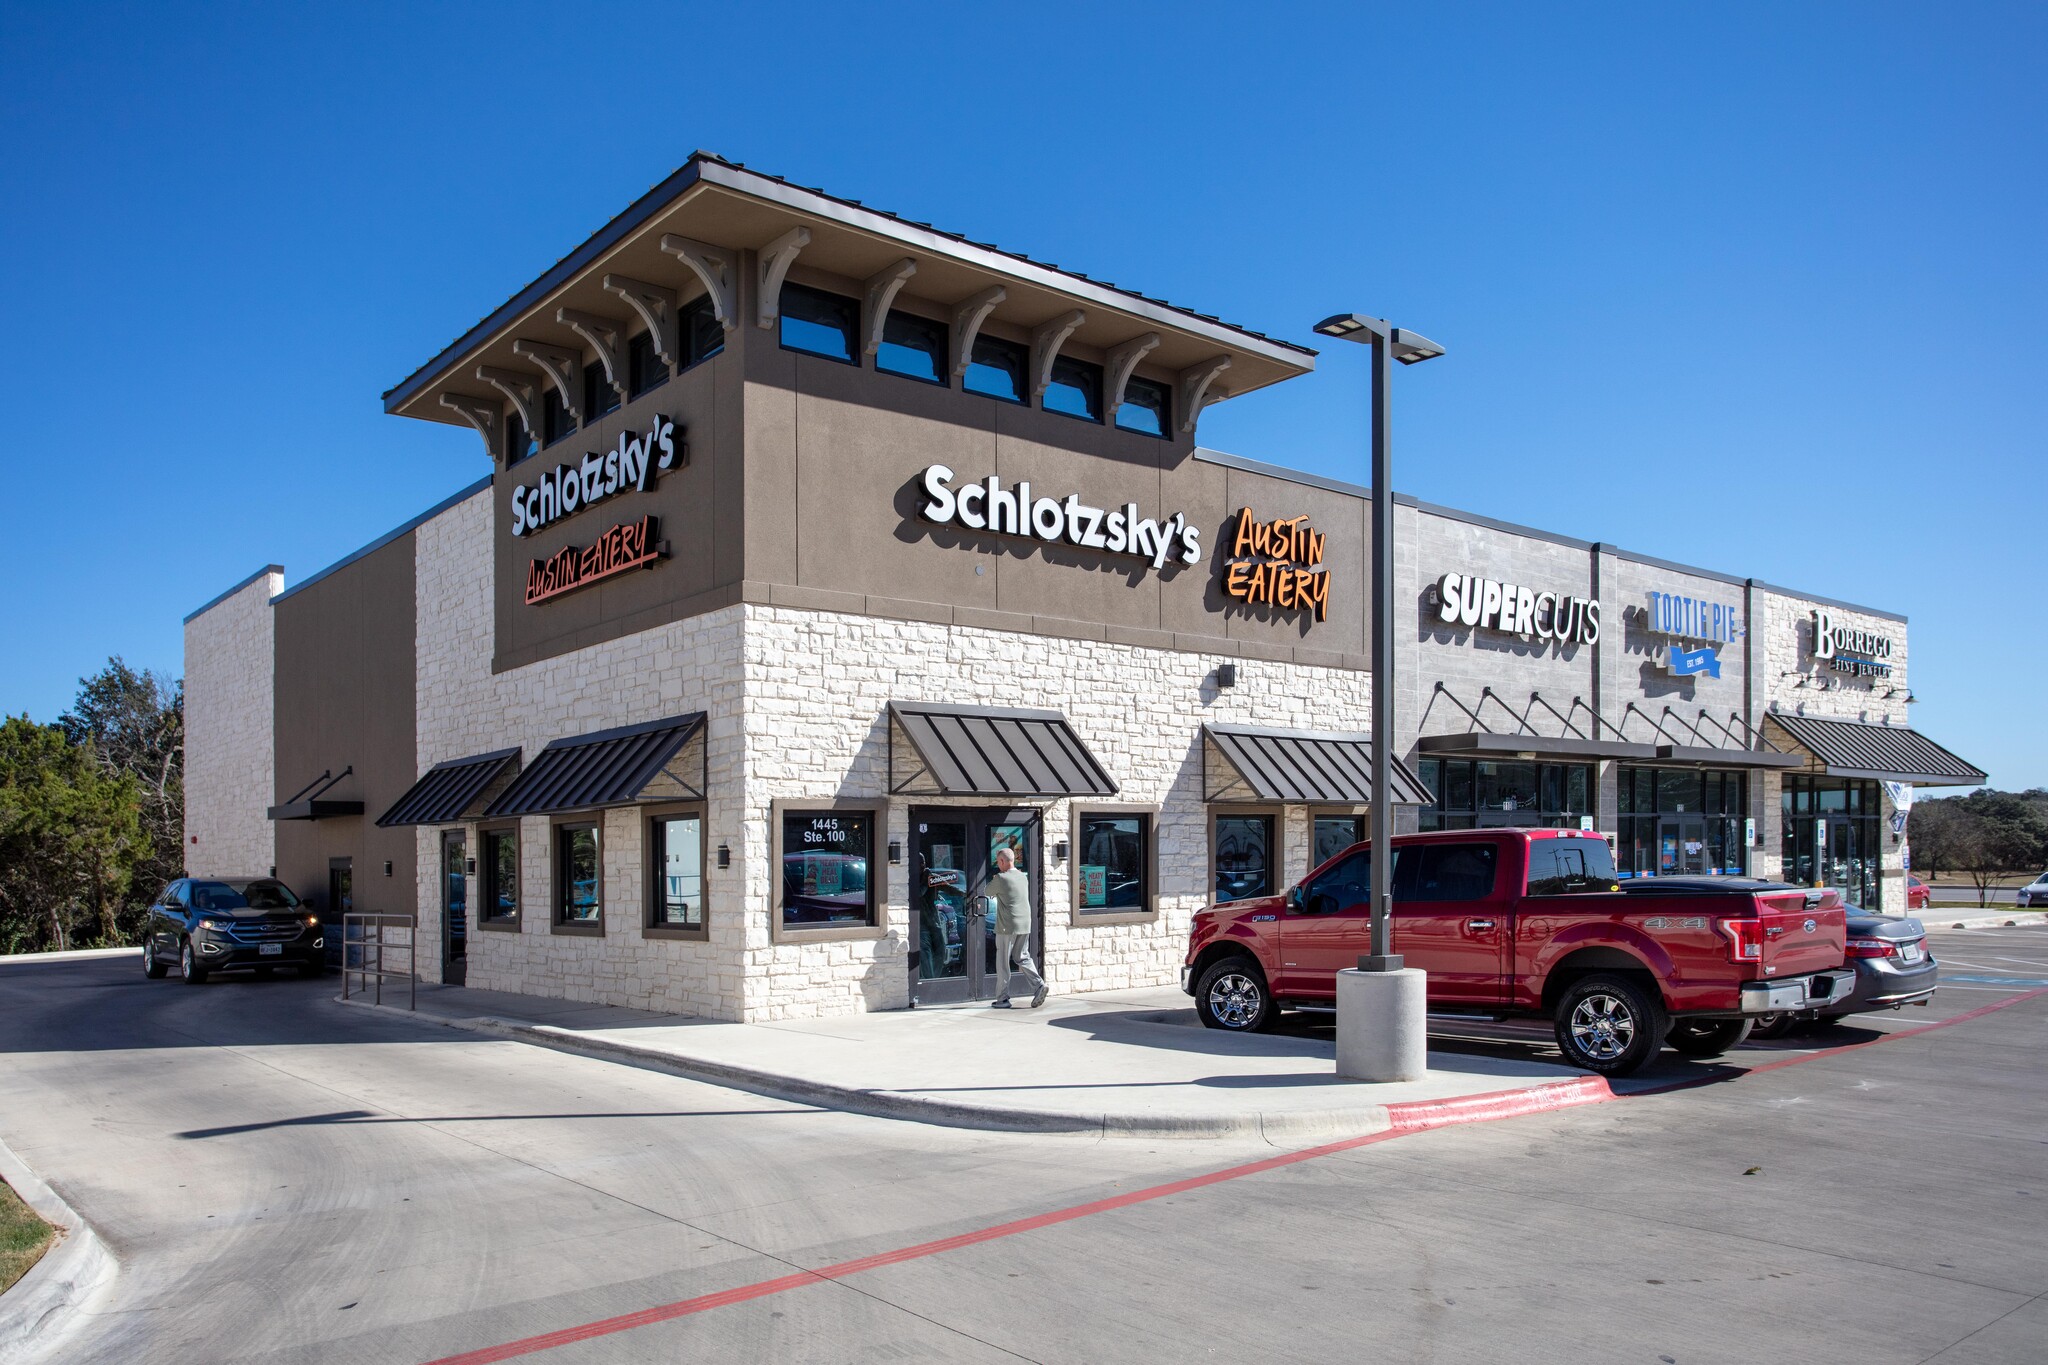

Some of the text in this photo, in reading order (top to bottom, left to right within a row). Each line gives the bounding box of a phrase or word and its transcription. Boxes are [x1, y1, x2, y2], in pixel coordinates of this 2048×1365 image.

[511, 413, 674, 537] Schlotzsky's
[922, 464, 1202, 570] Schlotzsky's
[1233, 506, 1326, 566] AUSTIN
[525, 515, 649, 605] AUSTIN EATERY
[1227, 561, 1331, 623] EATERY
[1440, 572, 1600, 645] SUPERCUTS
[1652, 591, 1735, 643] TOOTIE PIE
[1815, 609, 1892, 659] BORREGO
[1836, 659, 1892, 679] FINE JEWELRY
[804, 831, 845, 843] Ste. 100
[811, 819, 838, 830] 1445
[1556, 1082, 1583, 1101] LANE
